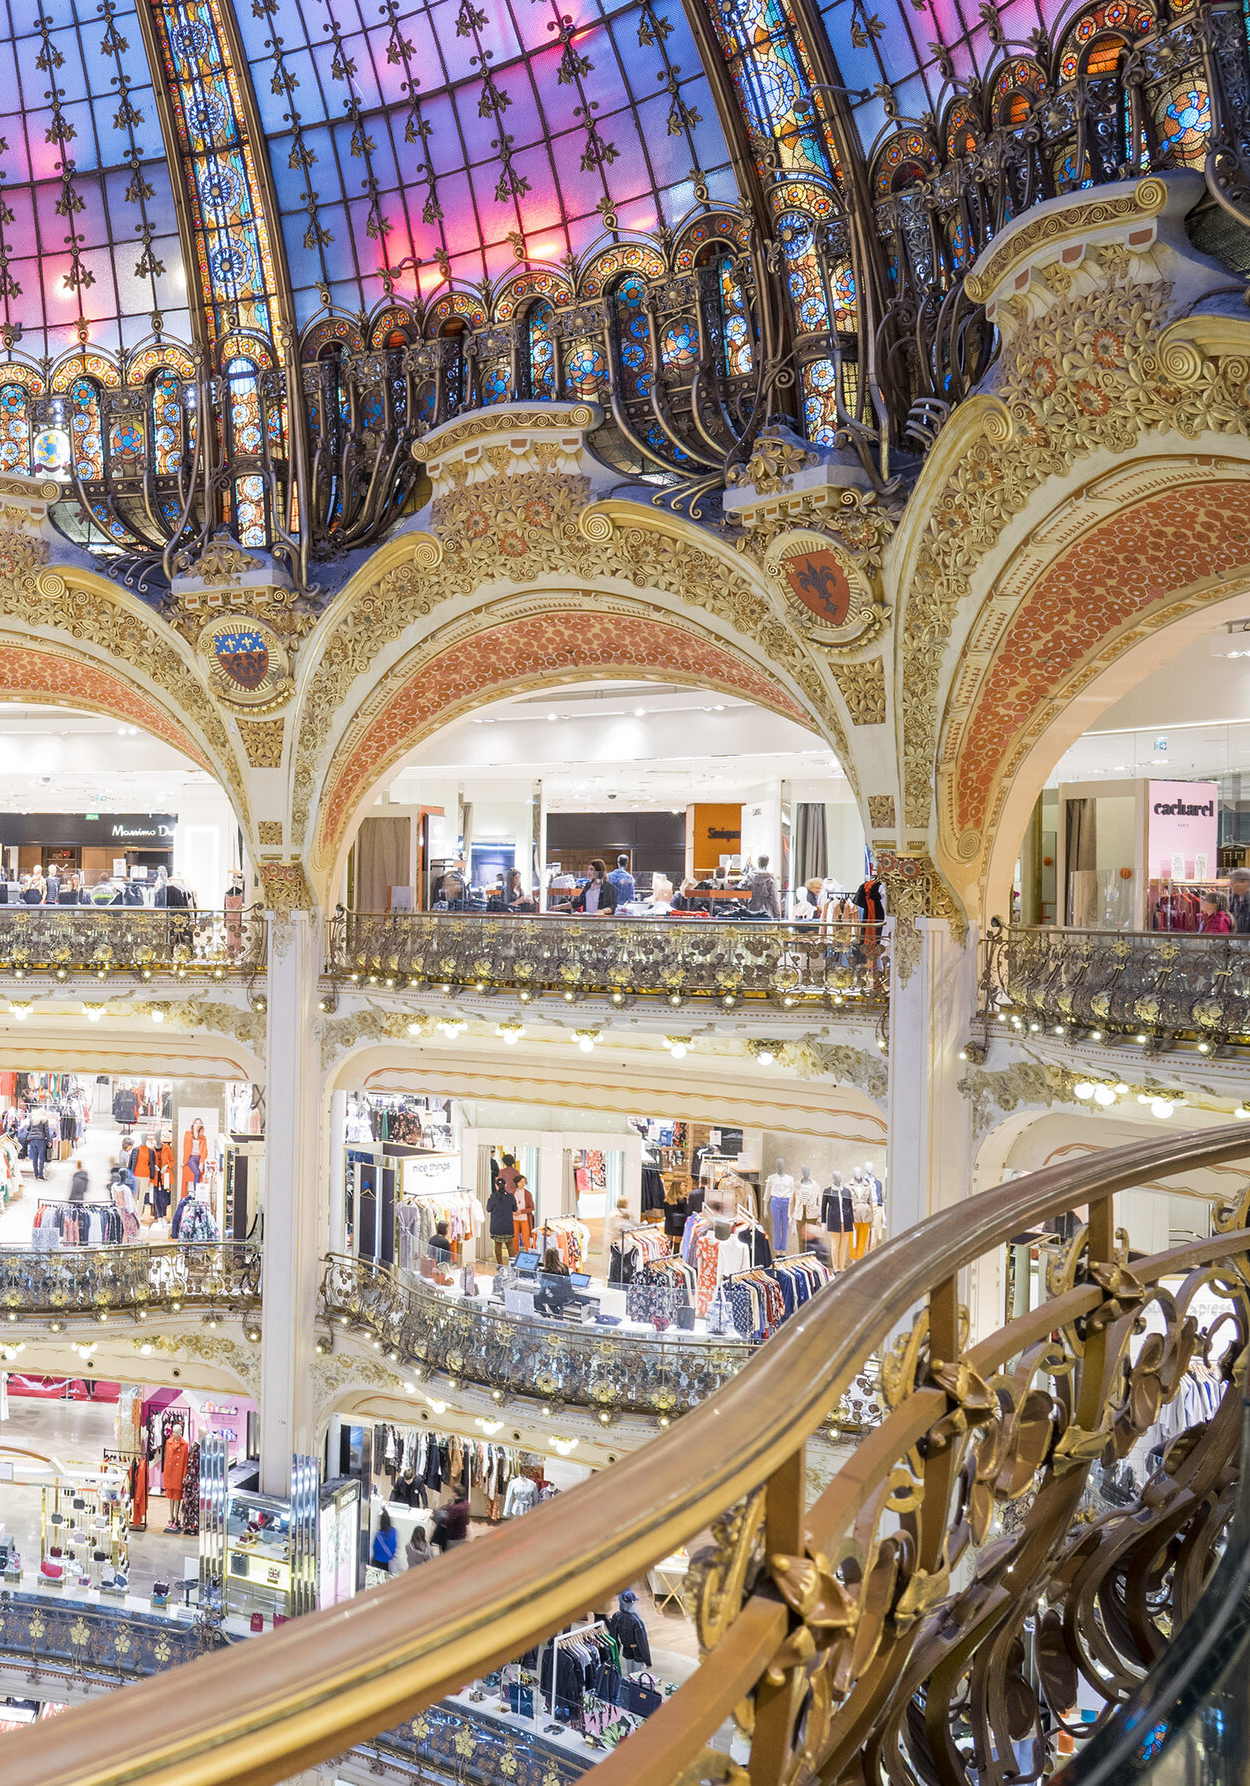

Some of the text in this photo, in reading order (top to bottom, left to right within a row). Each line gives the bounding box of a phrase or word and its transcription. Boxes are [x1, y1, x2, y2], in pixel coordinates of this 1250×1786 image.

[1154, 799, 1214, 817] cacharel
[111, 825, 156, 837] Massimo
[413, 1164, 428, 1173] nice
[1190, 1303, 1232, 1316] xpress
